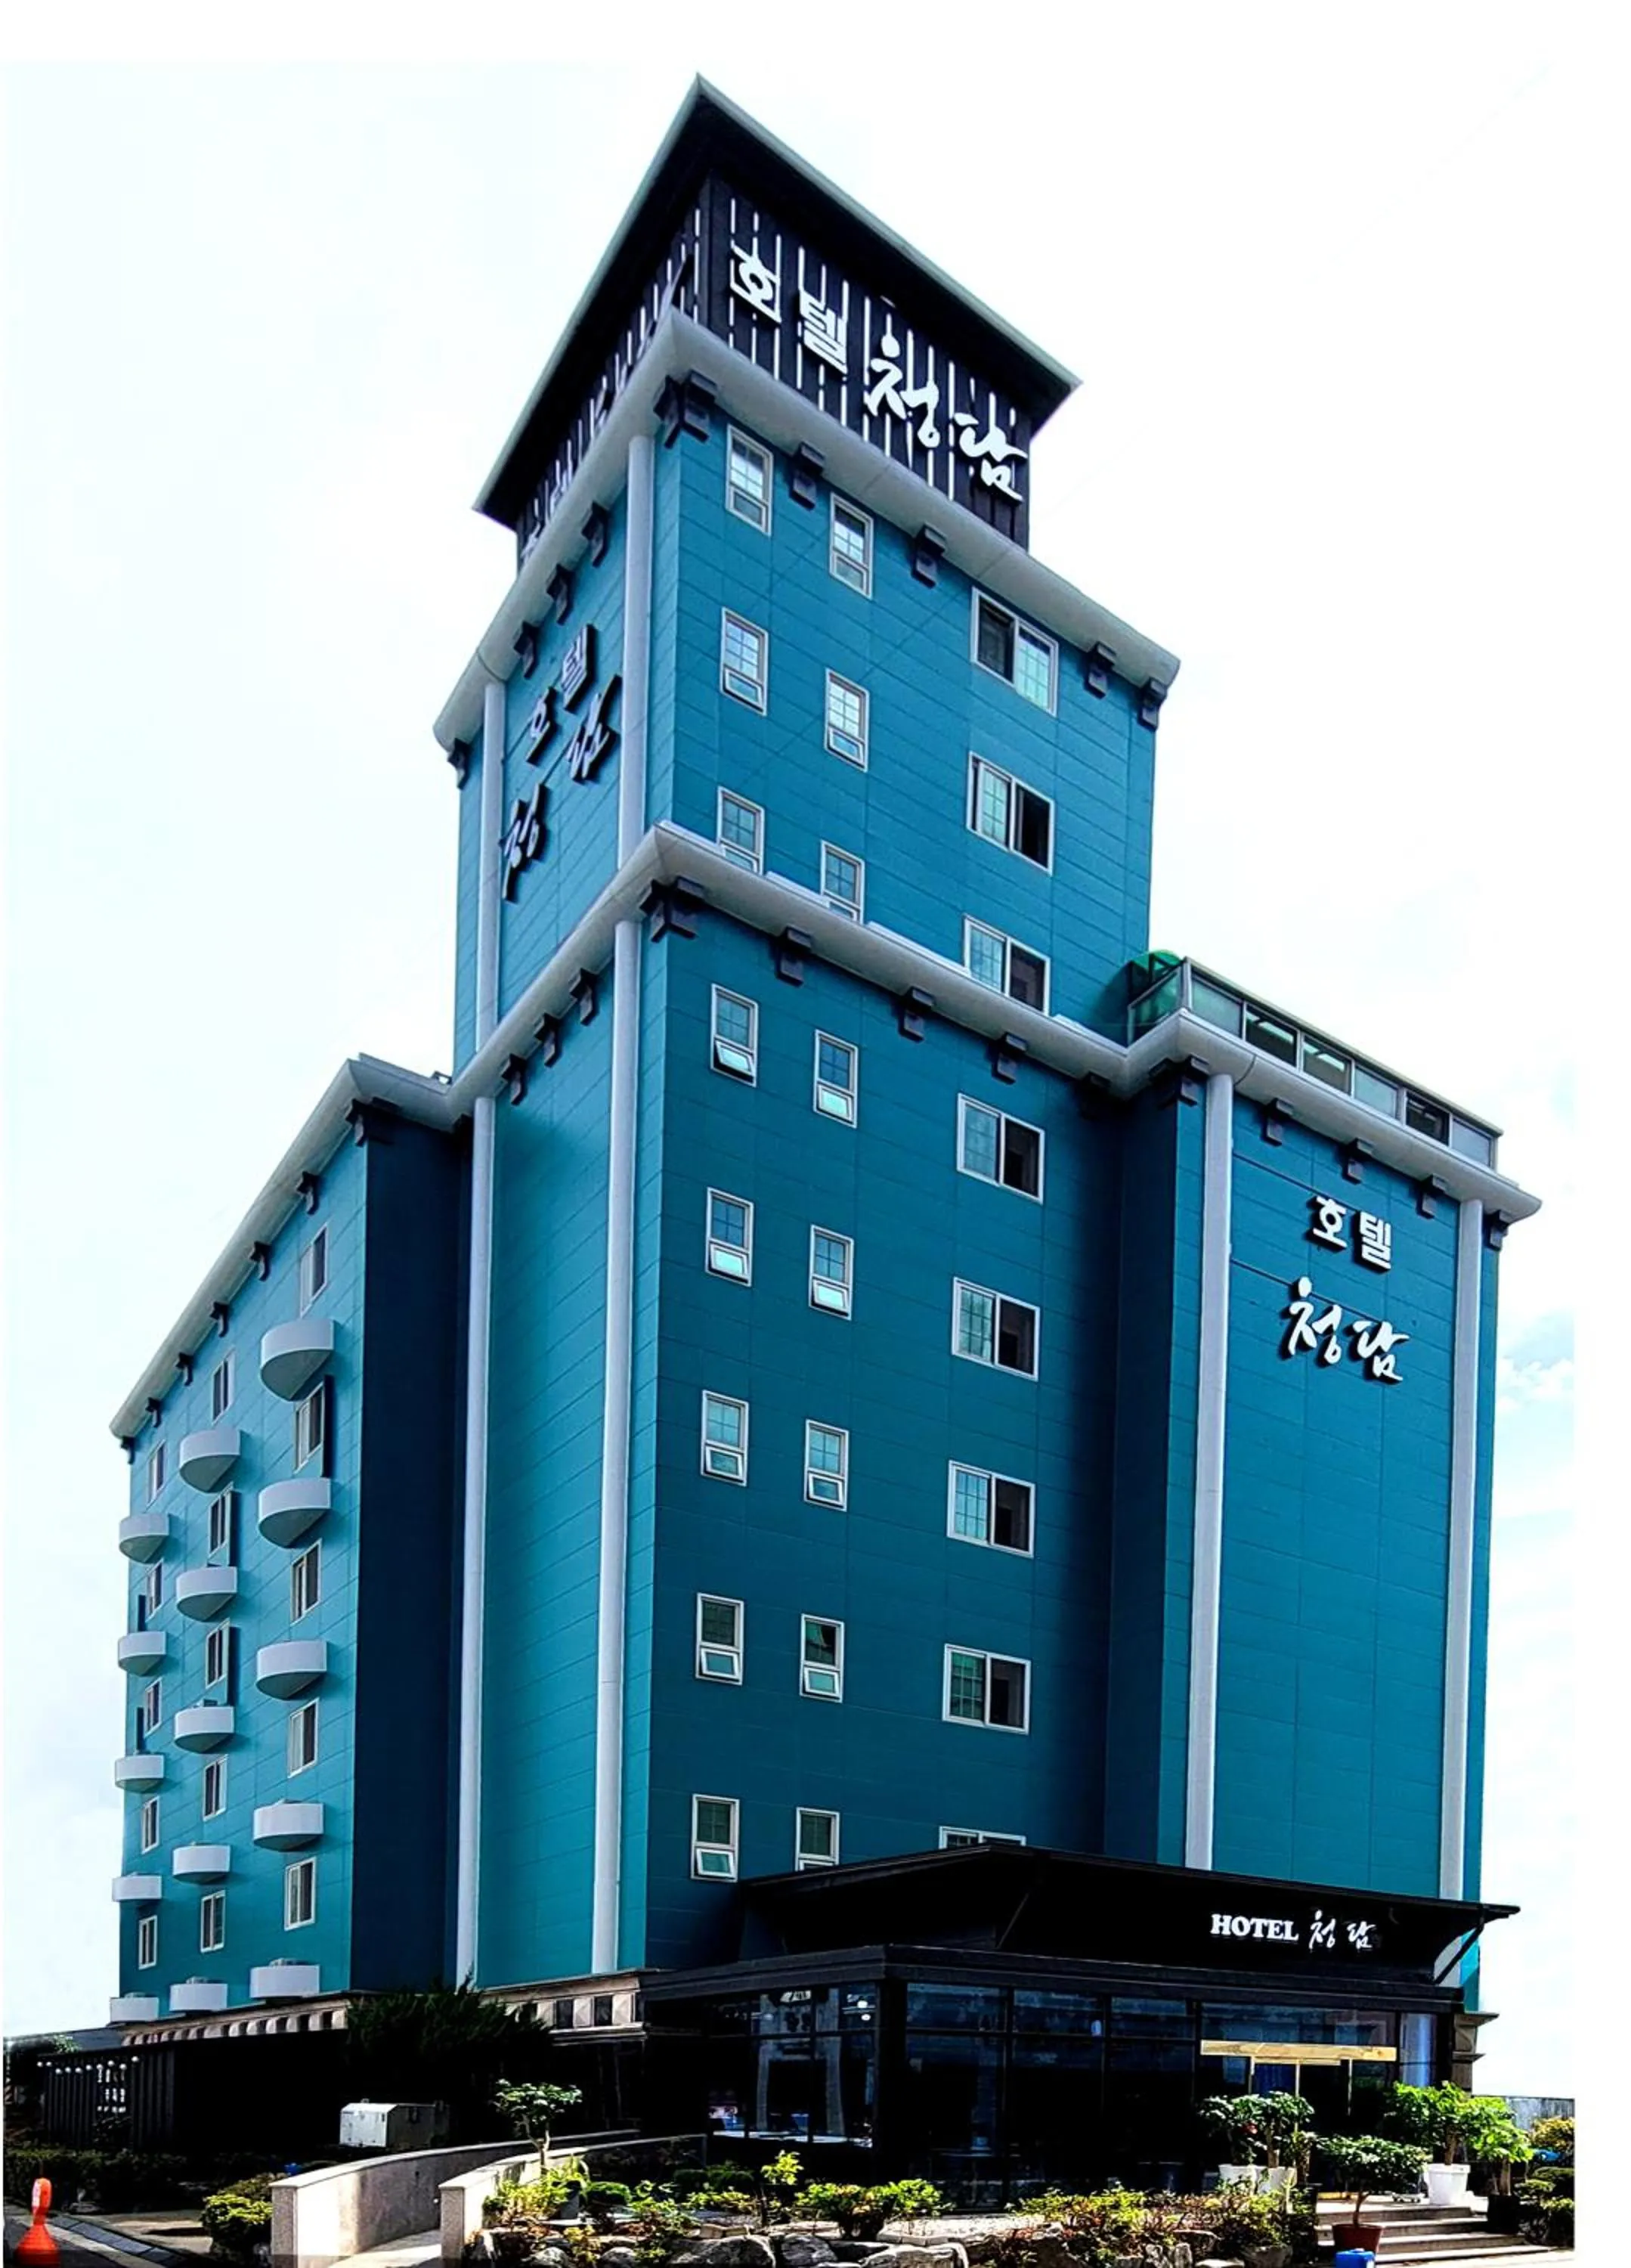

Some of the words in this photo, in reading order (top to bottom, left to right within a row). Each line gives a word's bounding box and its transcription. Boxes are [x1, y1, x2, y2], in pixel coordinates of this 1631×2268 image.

[730, 242, 848, 375] 호텔
[865, 333, 1029, 503] 청담
[1311, 1195, 1392, 1270] 호텔
[1287, 1275, 1411, 1382] 청담
[1210, 1913, 1300, 1942] HOTEL
